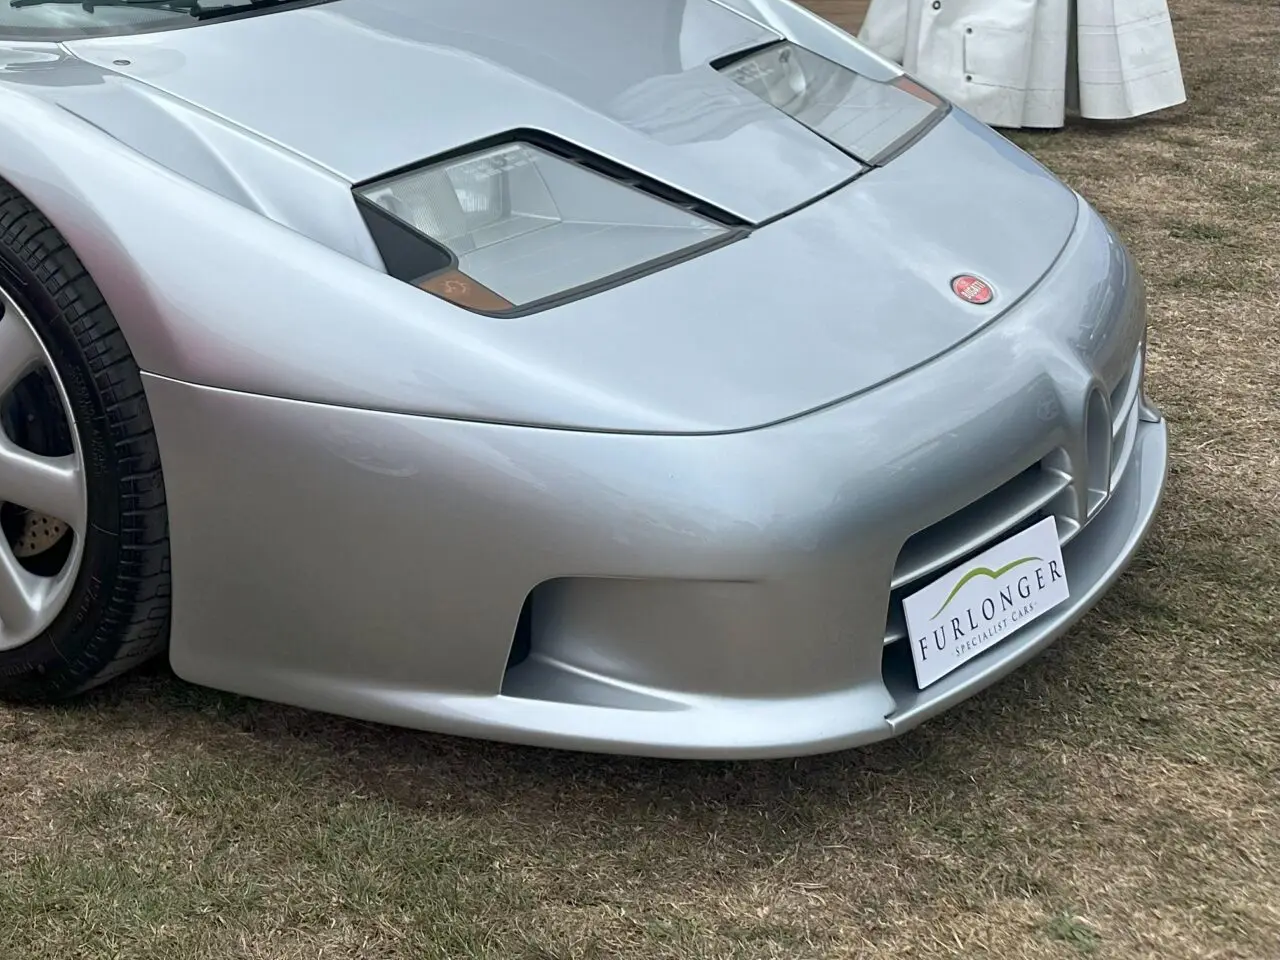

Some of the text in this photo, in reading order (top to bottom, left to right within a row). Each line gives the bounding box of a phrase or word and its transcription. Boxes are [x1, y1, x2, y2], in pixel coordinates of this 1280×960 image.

[918, 559, 1063, 661] FURLONGER
[954, 603, 1036, 658] SPECIALIST CARS
